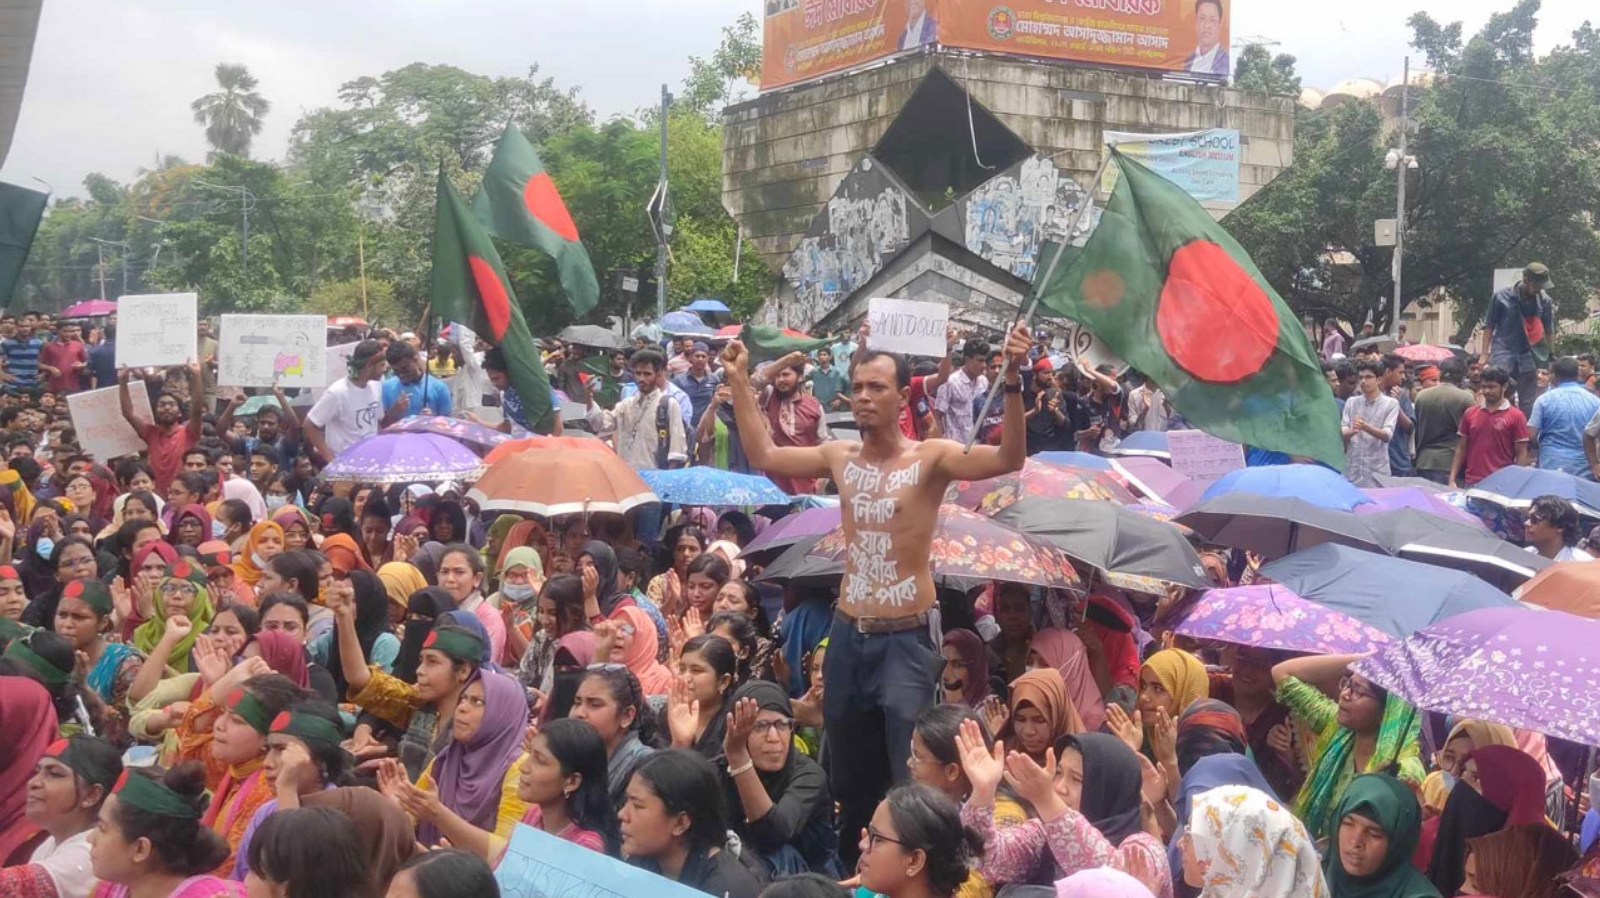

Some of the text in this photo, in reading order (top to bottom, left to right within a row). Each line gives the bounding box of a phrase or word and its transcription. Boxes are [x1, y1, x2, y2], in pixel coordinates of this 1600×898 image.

[1016, 20, 1170, 48] মোহাম্মদ আসাদুজ্জামান আসাদ
[1178, 149, 1234, 161] ENGLISH MEDIUM
[1189, 136, 1234, 150] SCHOOL
[869, 311, 890, 336] SAY
[889, 313, 903, 337] NO
[903, 314, 917, 336] TO
[843, 459, 922, 493] কোটা প্রথা
[850, 492, 899, 524] নিপাত
[856, 529, 893, 558] যাক
[875, 575, 917, 606] পাক
